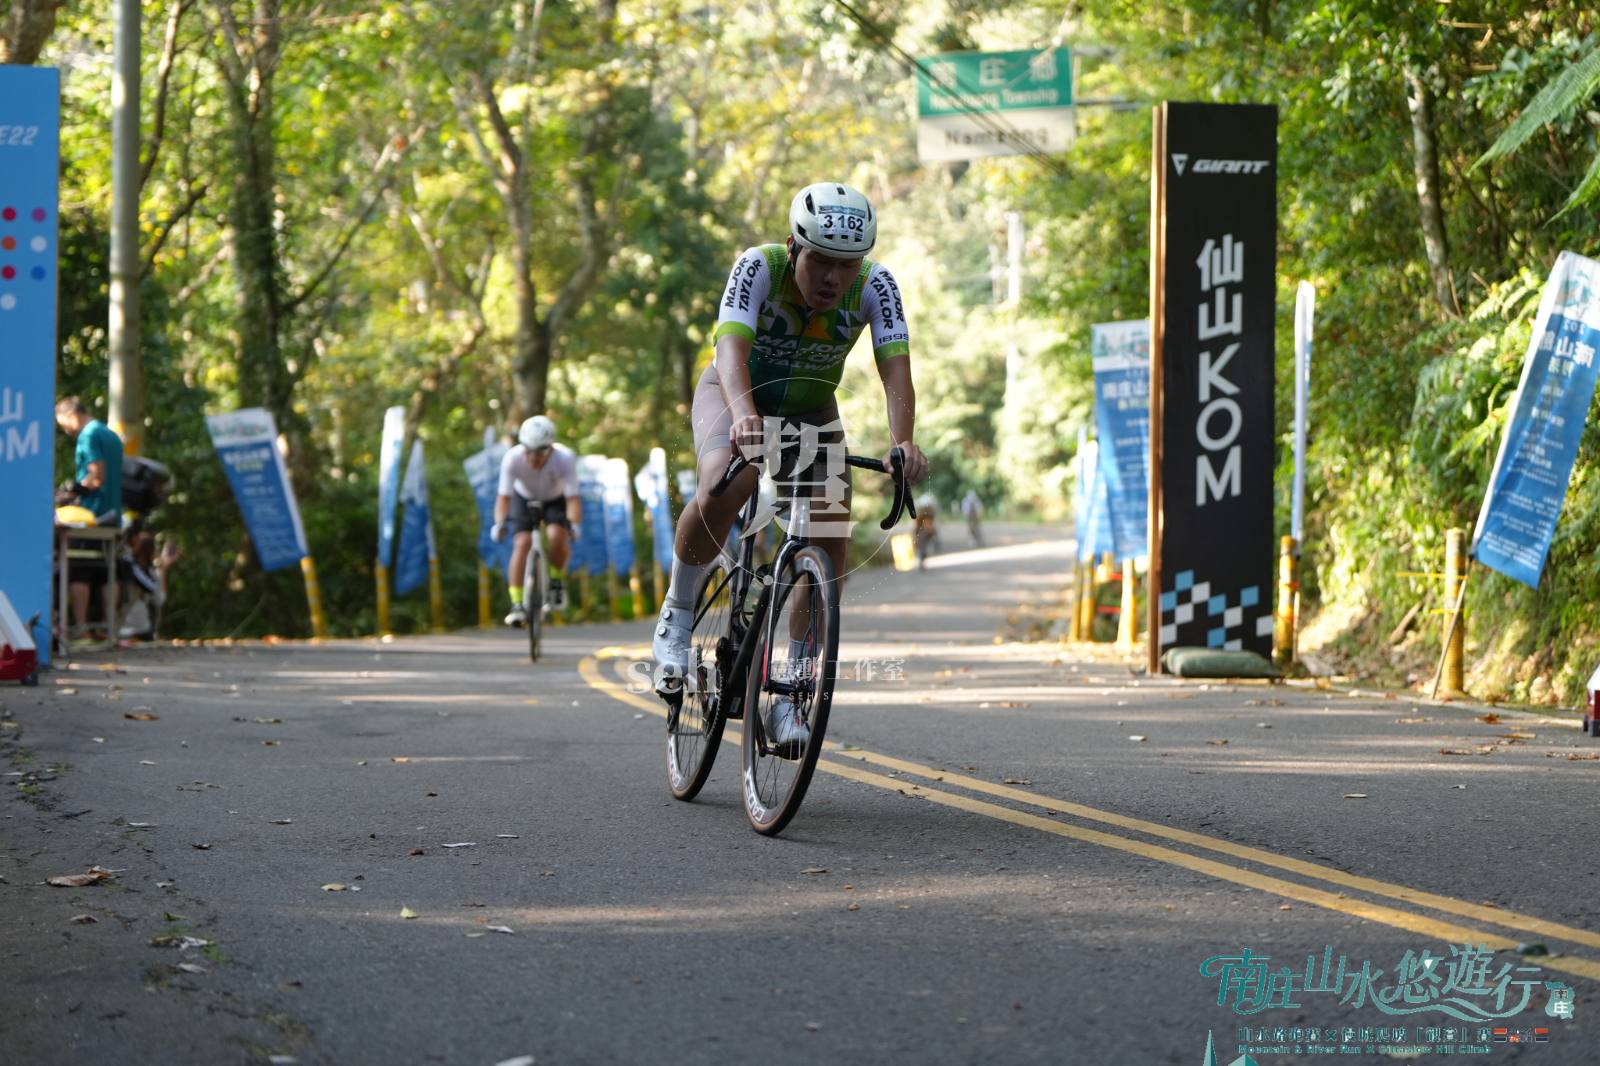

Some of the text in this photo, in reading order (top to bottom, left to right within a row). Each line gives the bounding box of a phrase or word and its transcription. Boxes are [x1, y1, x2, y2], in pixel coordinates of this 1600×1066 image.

[1192, 159, 1270, 174] GIANT
[823, 214, 864, 233] 3162
[725, 257, 749, 308] MAJOR
[738, 259, 763, 312] TAYLOR
[870, 276, 893, 330] TAYLOR
[879, 270, 904, 322] MAJOR
